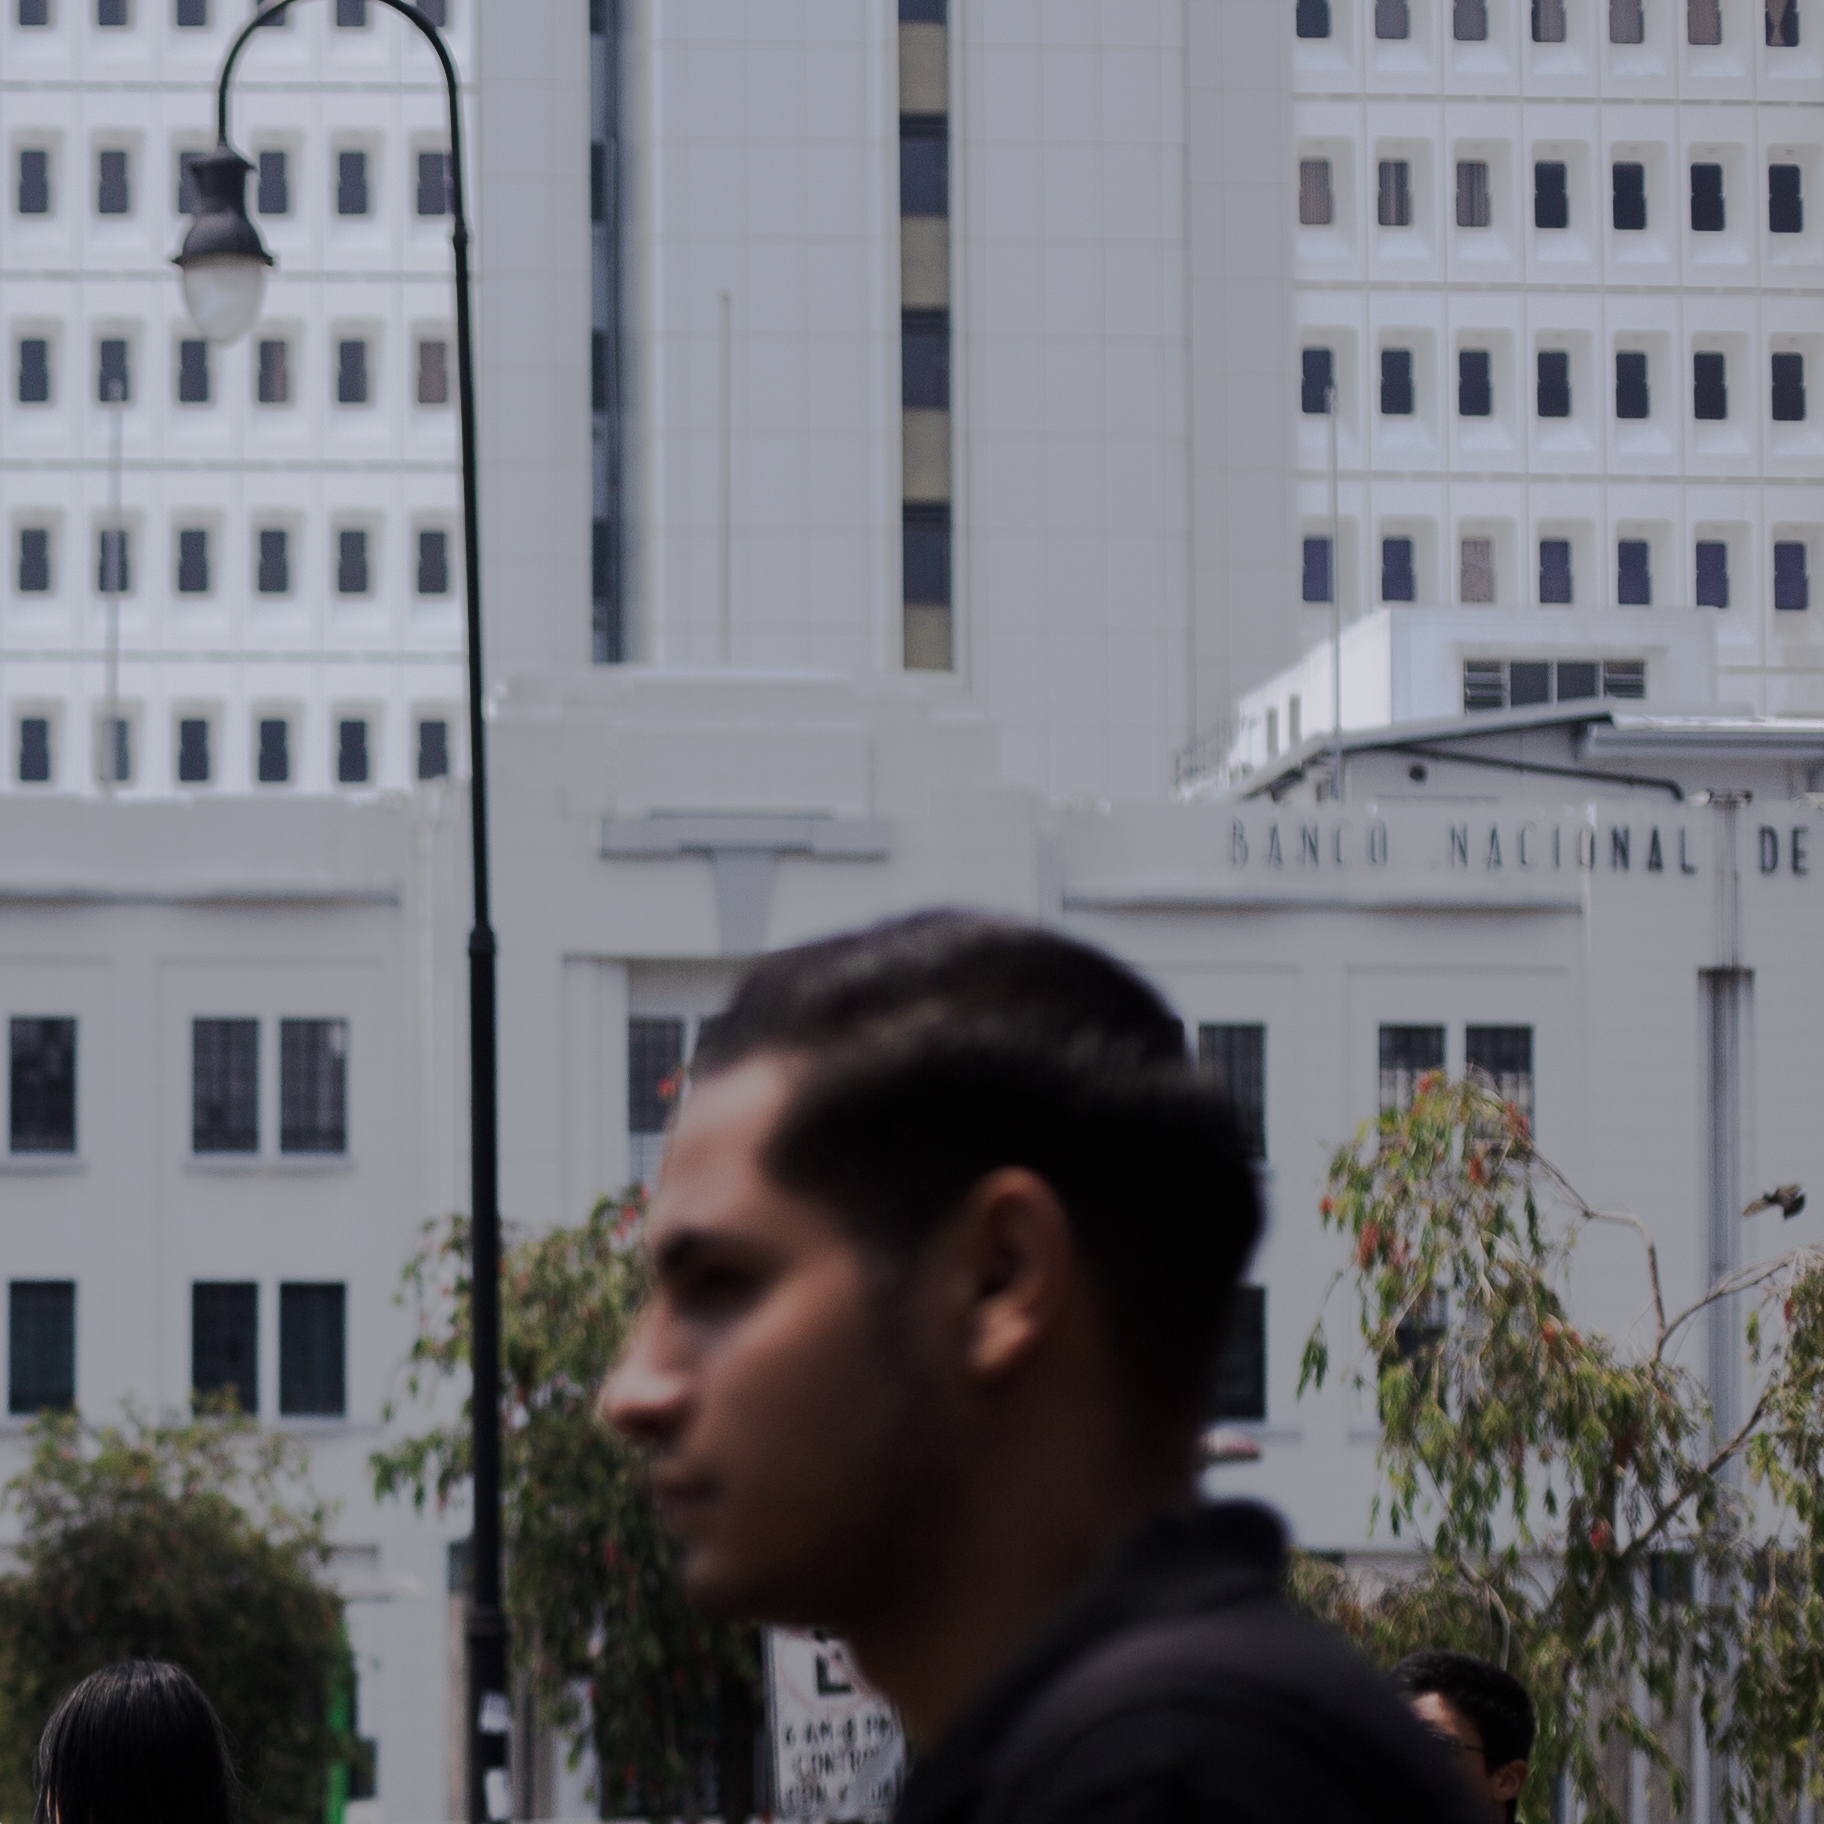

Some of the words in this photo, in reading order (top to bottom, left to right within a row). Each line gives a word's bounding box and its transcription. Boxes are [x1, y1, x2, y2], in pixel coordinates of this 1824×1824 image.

[1228, 820, 1390, 870] BANCO
[1450, 823, 1698, 877] NACIONAL
[1758, 825, 1810, 877] DE
